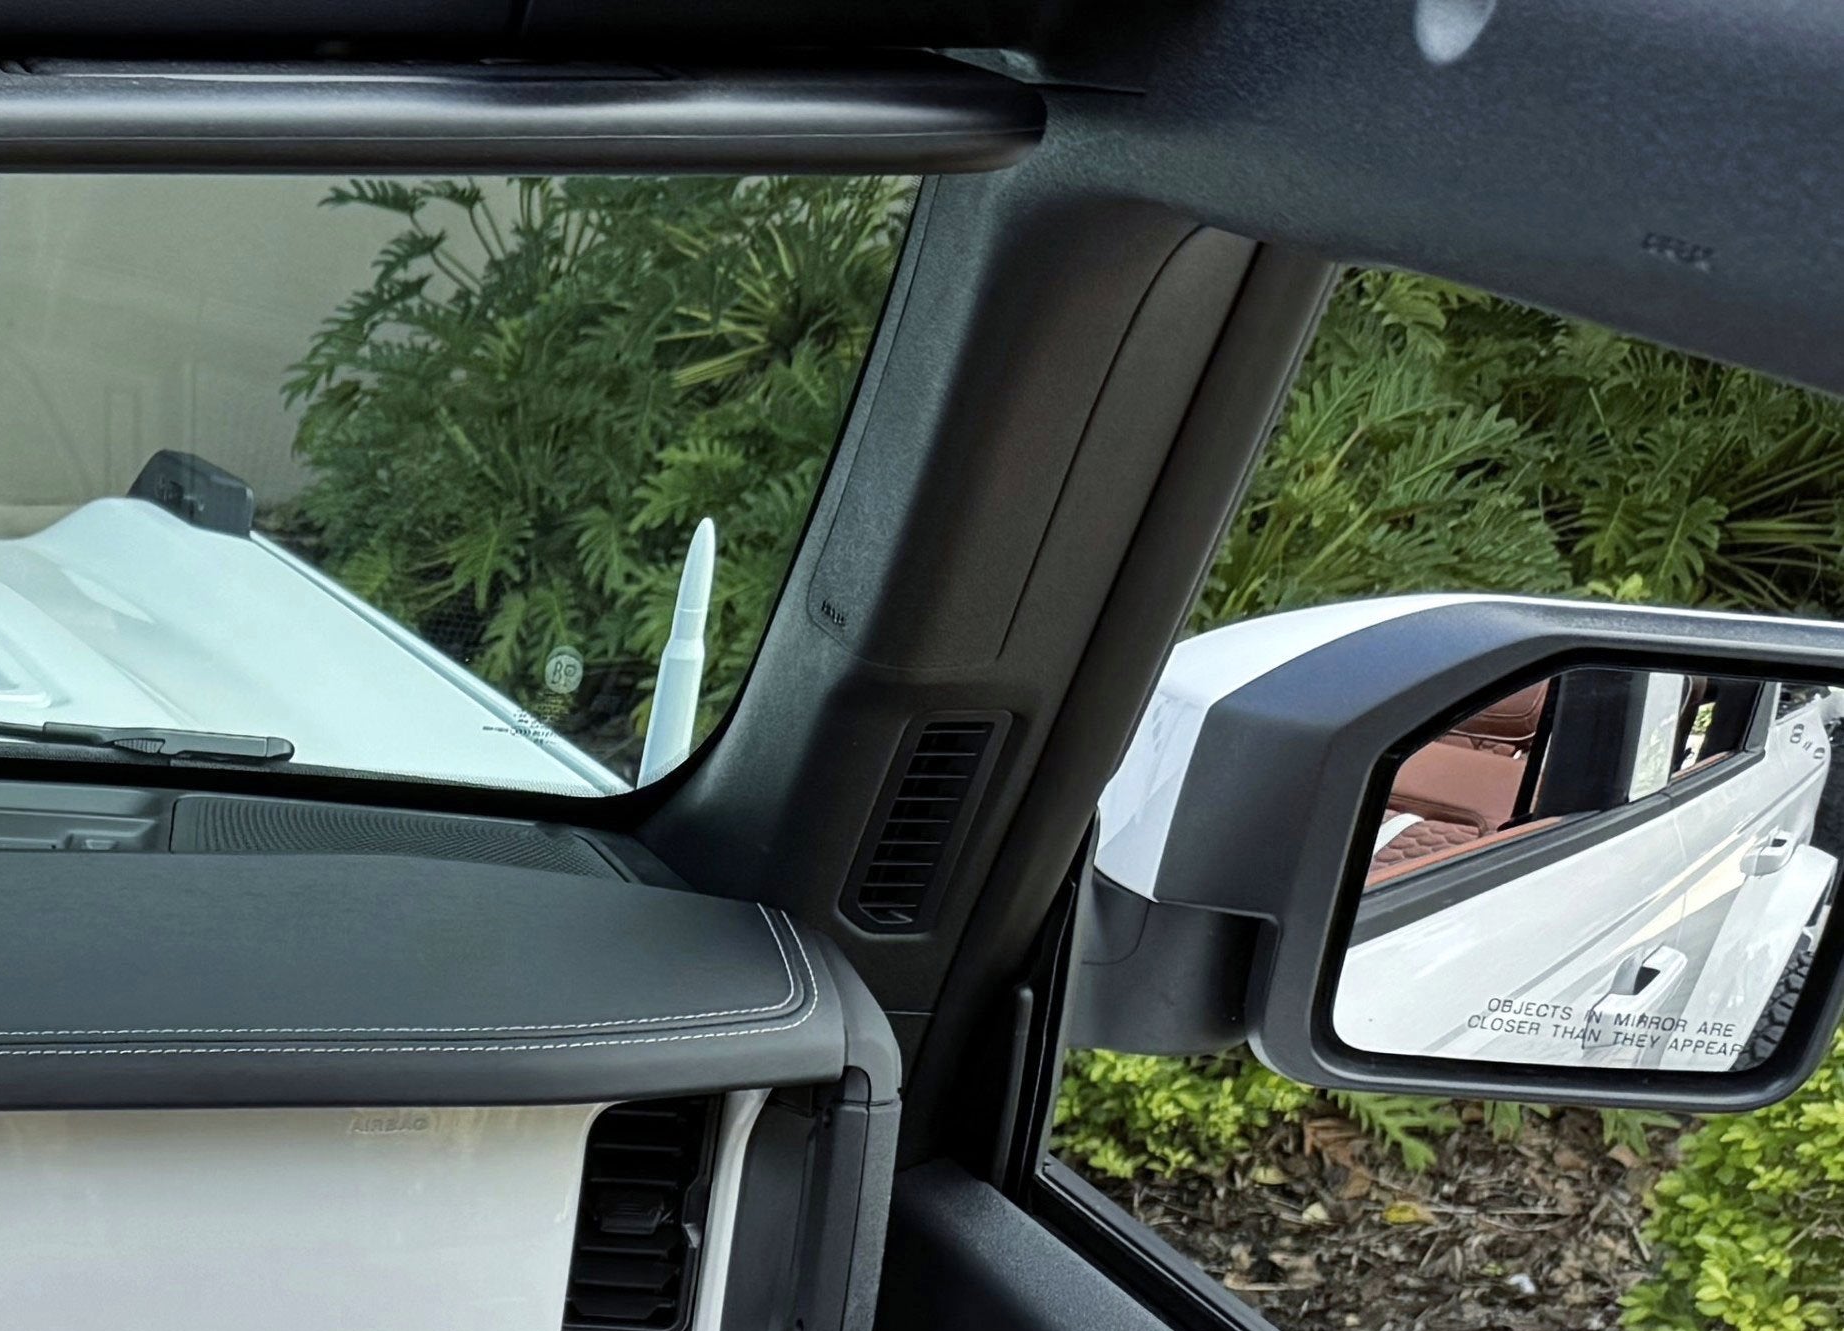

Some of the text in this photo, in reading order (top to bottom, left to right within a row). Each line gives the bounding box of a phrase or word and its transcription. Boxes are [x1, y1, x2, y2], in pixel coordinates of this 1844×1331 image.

[1467, 1015, 1540, 1035] CLOSER
[1553, 1024, 1601, 1043] THAN
[1613, 1031, 1661, 1048] THEY
[1488, 998, 1736, 1038] OBJECTS IN MIRROR ARE
